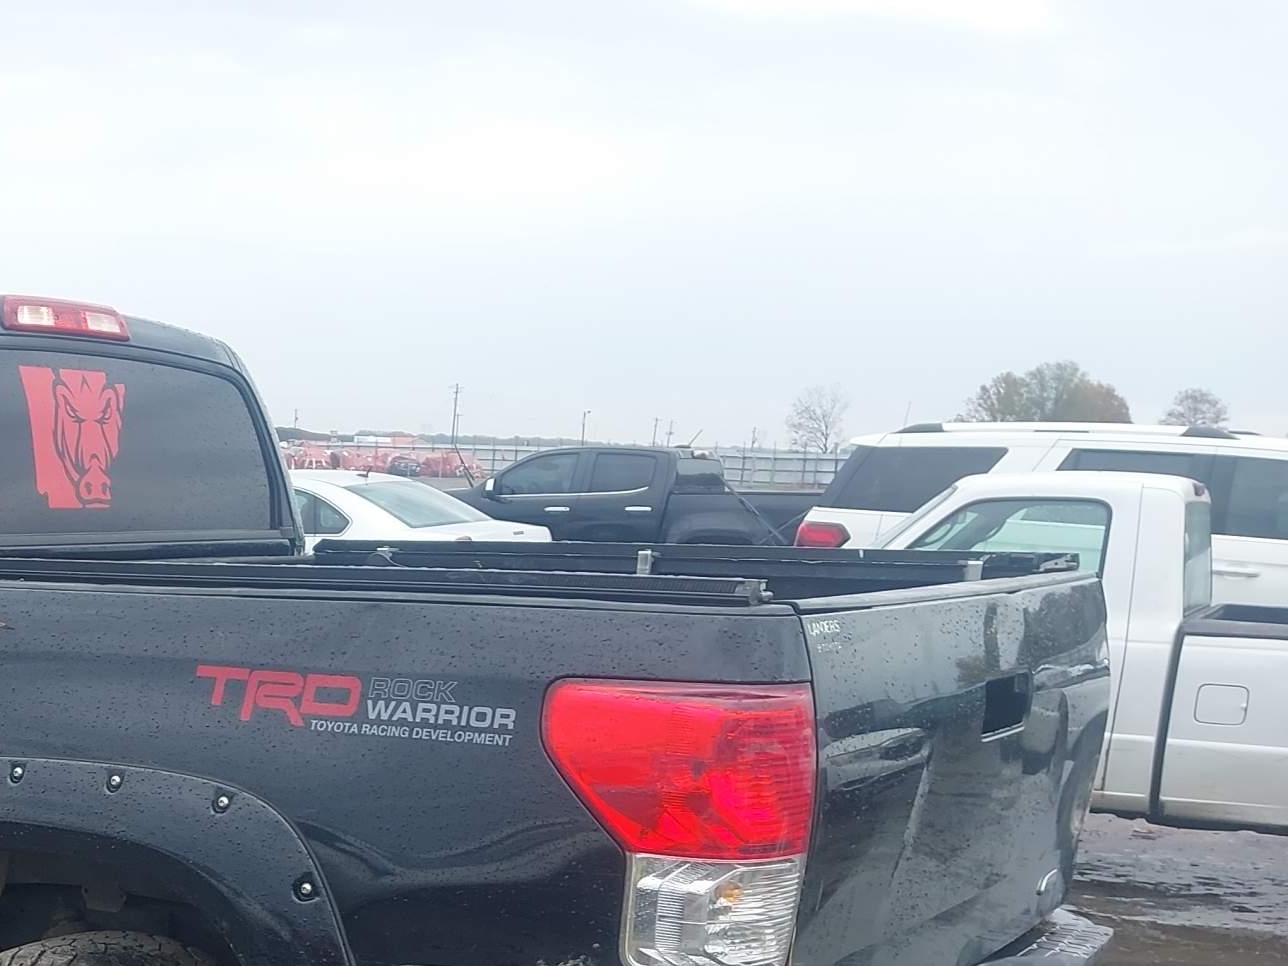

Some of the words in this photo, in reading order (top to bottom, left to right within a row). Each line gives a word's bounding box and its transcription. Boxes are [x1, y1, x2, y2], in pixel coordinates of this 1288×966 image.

[807, 620, 840, 636] LANDERS
[196, 664, 361, 727] TRD
[368, 677, 458, 703] ROCK
[367, 700, 516, 730] WARRIOR
[310, 720, 358, 735] TOYOTA
[361, 724, 409, 738] RACING
[412, 728, 512, 746] DEVELOPMENT
